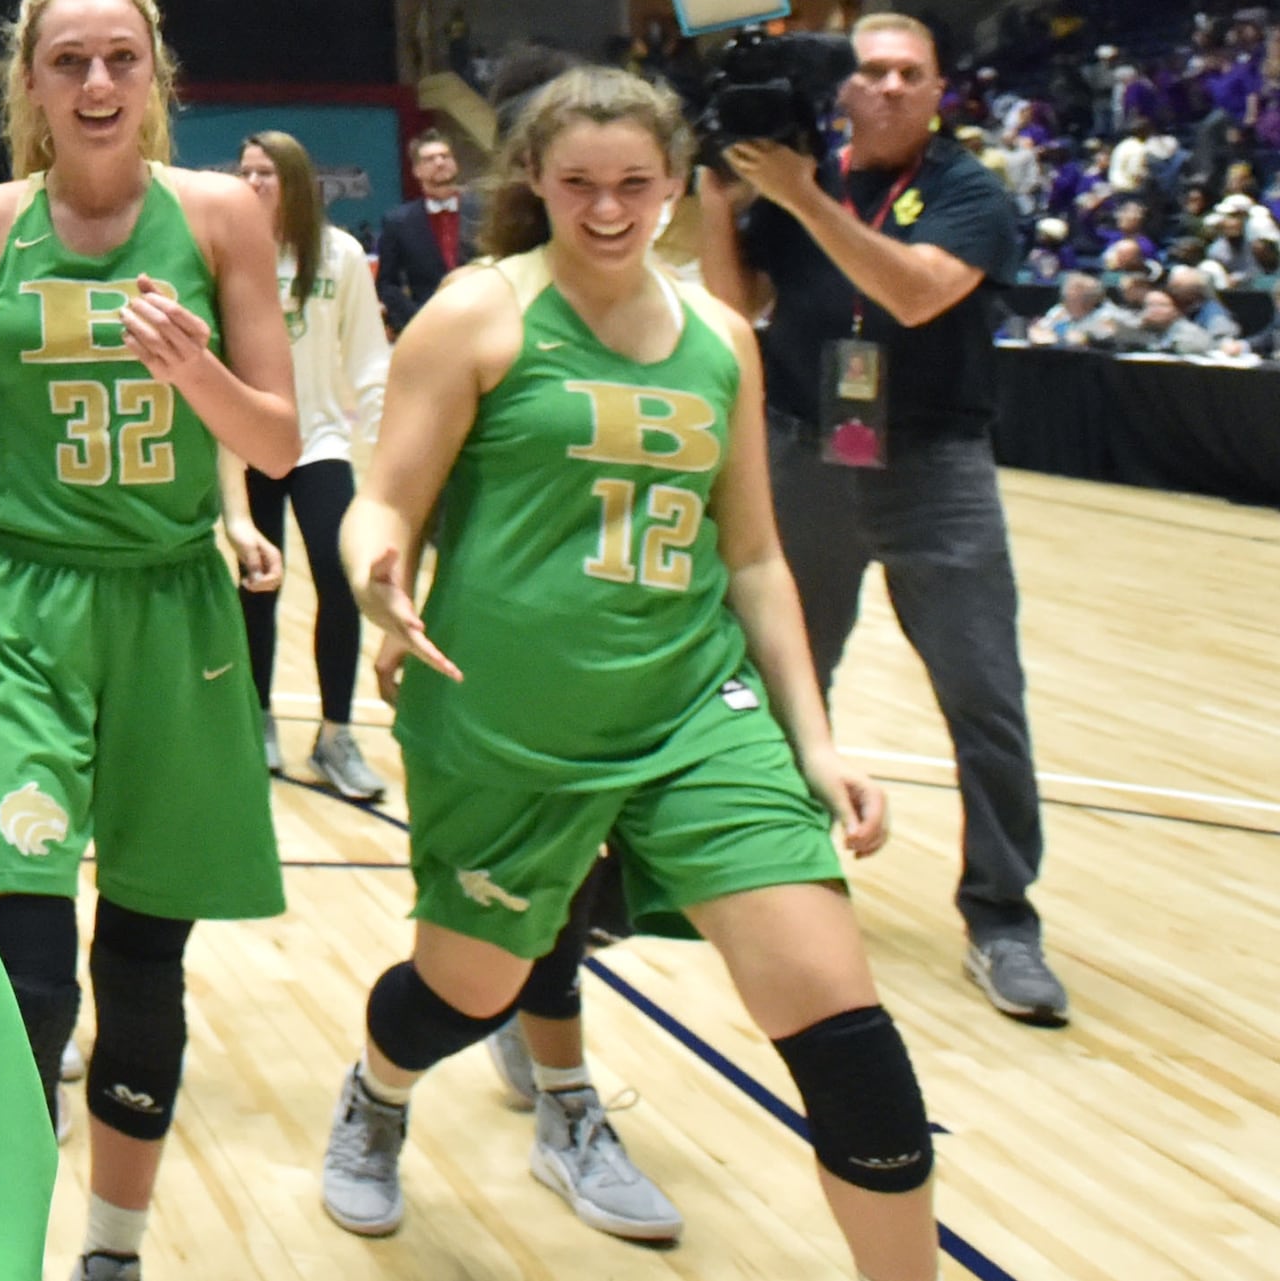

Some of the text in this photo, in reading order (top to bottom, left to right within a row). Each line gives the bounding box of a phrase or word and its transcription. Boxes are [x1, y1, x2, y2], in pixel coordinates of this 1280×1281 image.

[18, 277, 178, 364] B
[48, 379, 175, 486] 32
[563, 380, 721, 472] B
[583, 477, 703, 592] 12
